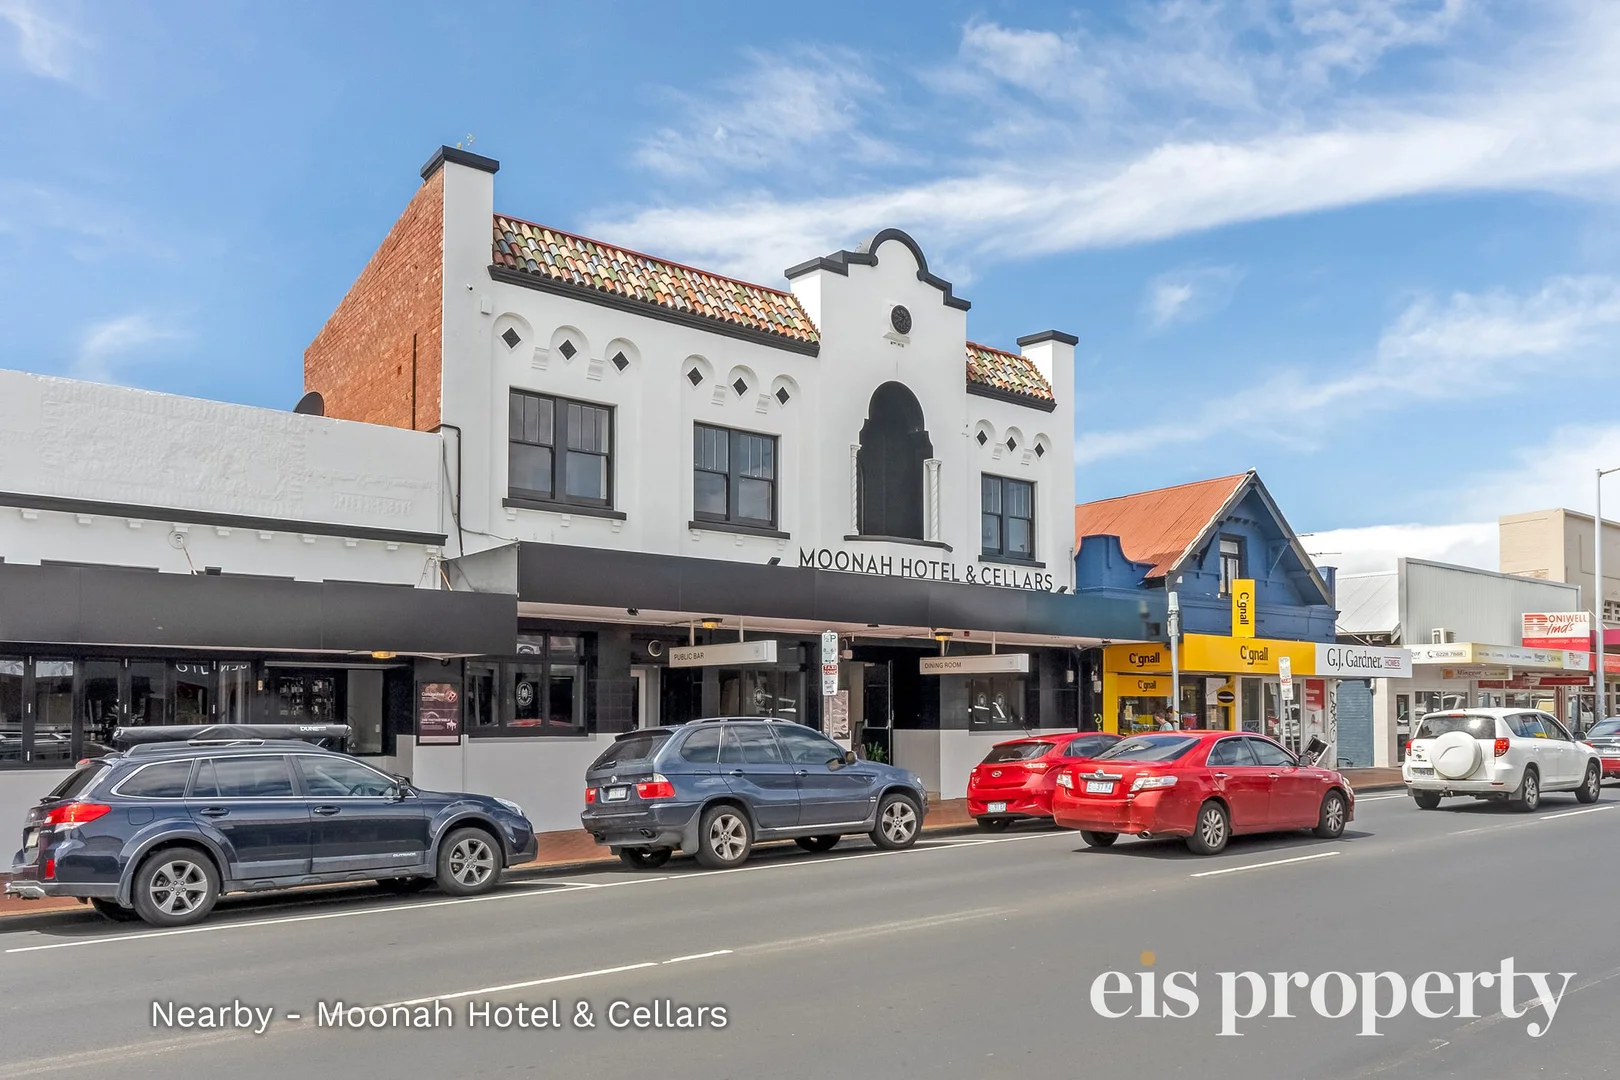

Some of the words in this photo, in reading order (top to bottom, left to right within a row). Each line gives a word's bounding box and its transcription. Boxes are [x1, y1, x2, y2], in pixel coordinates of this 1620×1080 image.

[799, 547, 892, 575] MOONAH
[901, 557, 960, 583] HOTEL
[965, 565, 977, 584] &
[981, 567, 1053, 591] CELLARS
[674, 652, 693, 660] PUBLIC
[693, 651, 704, 659] BAR
[944, 661, 961, 669] ROOM
[1385, 659, 1400, 667] HOMES
